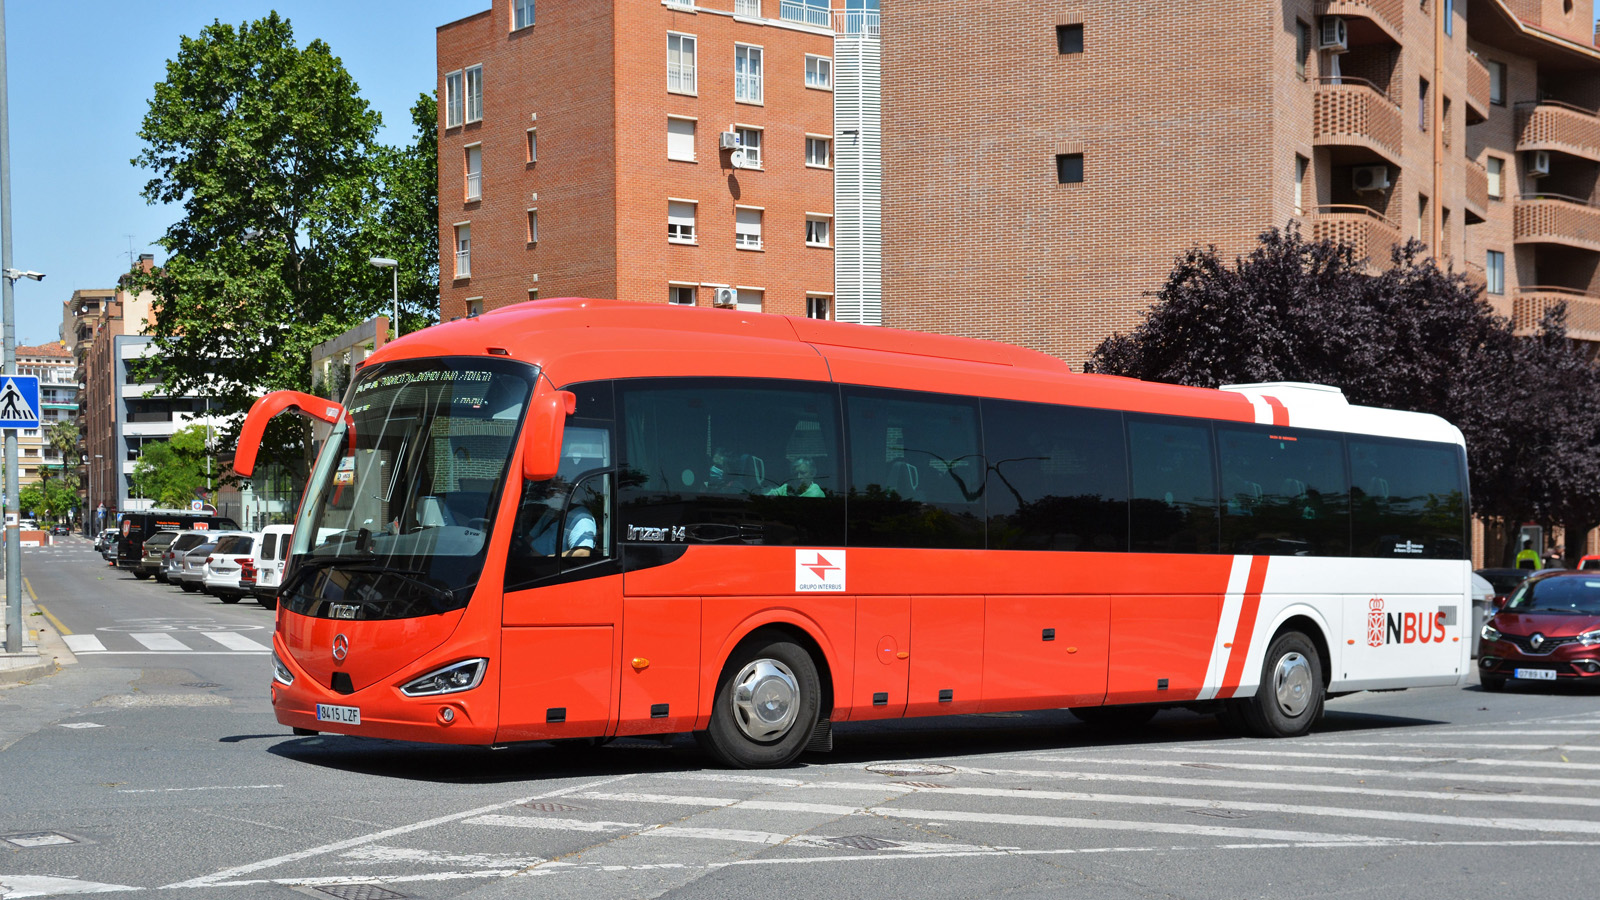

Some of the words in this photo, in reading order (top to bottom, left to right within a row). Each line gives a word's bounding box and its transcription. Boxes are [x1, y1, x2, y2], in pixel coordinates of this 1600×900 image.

[627, 524, 669, 541] Irizar
[671, 525, 686, 541] i4
[1386, 611, 1447, 645] NBUS
[321, 706, 341, 720] 8415
[342, 708, 358, 722] LZF
